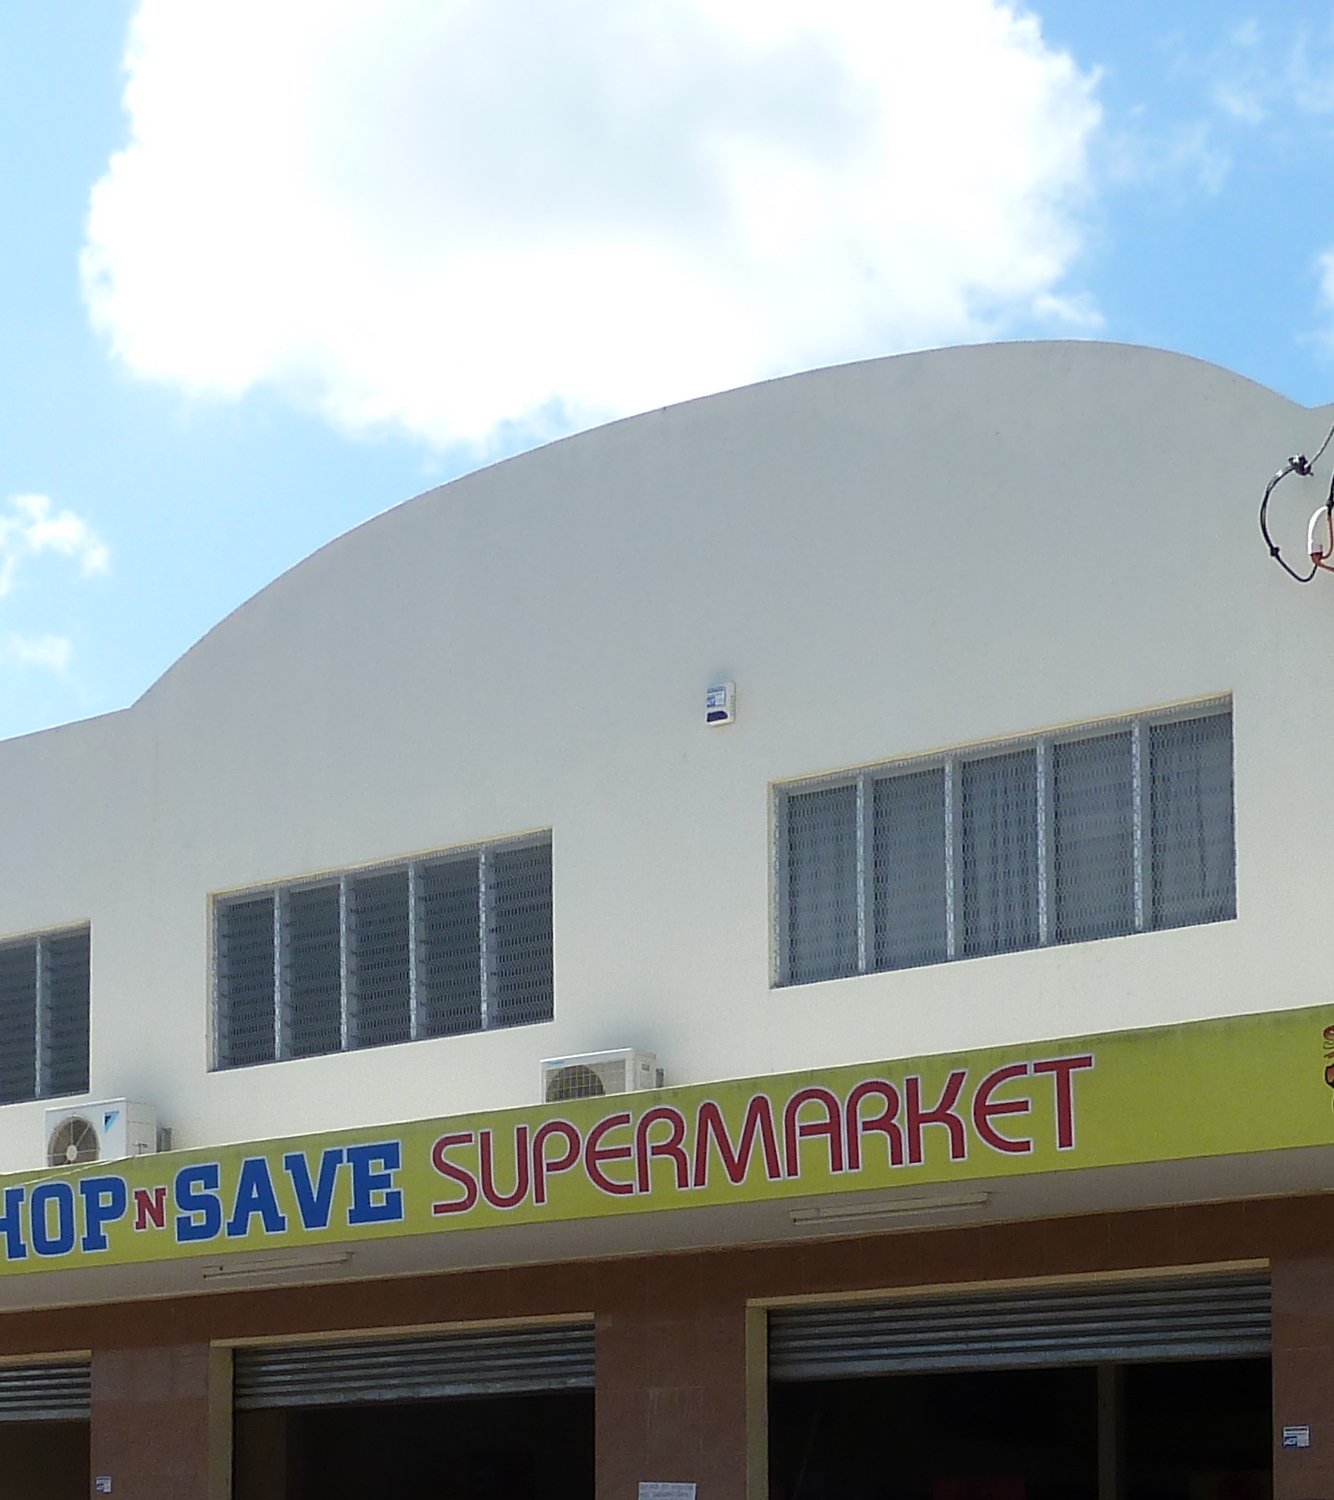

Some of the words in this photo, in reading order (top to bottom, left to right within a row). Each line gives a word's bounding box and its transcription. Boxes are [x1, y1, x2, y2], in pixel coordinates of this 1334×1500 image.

[133, 1186, 168, 1233] N
[174, 1141, 404, 1243] SAVE
[431, 1054, 1095, 1216] SUPERMARKET
